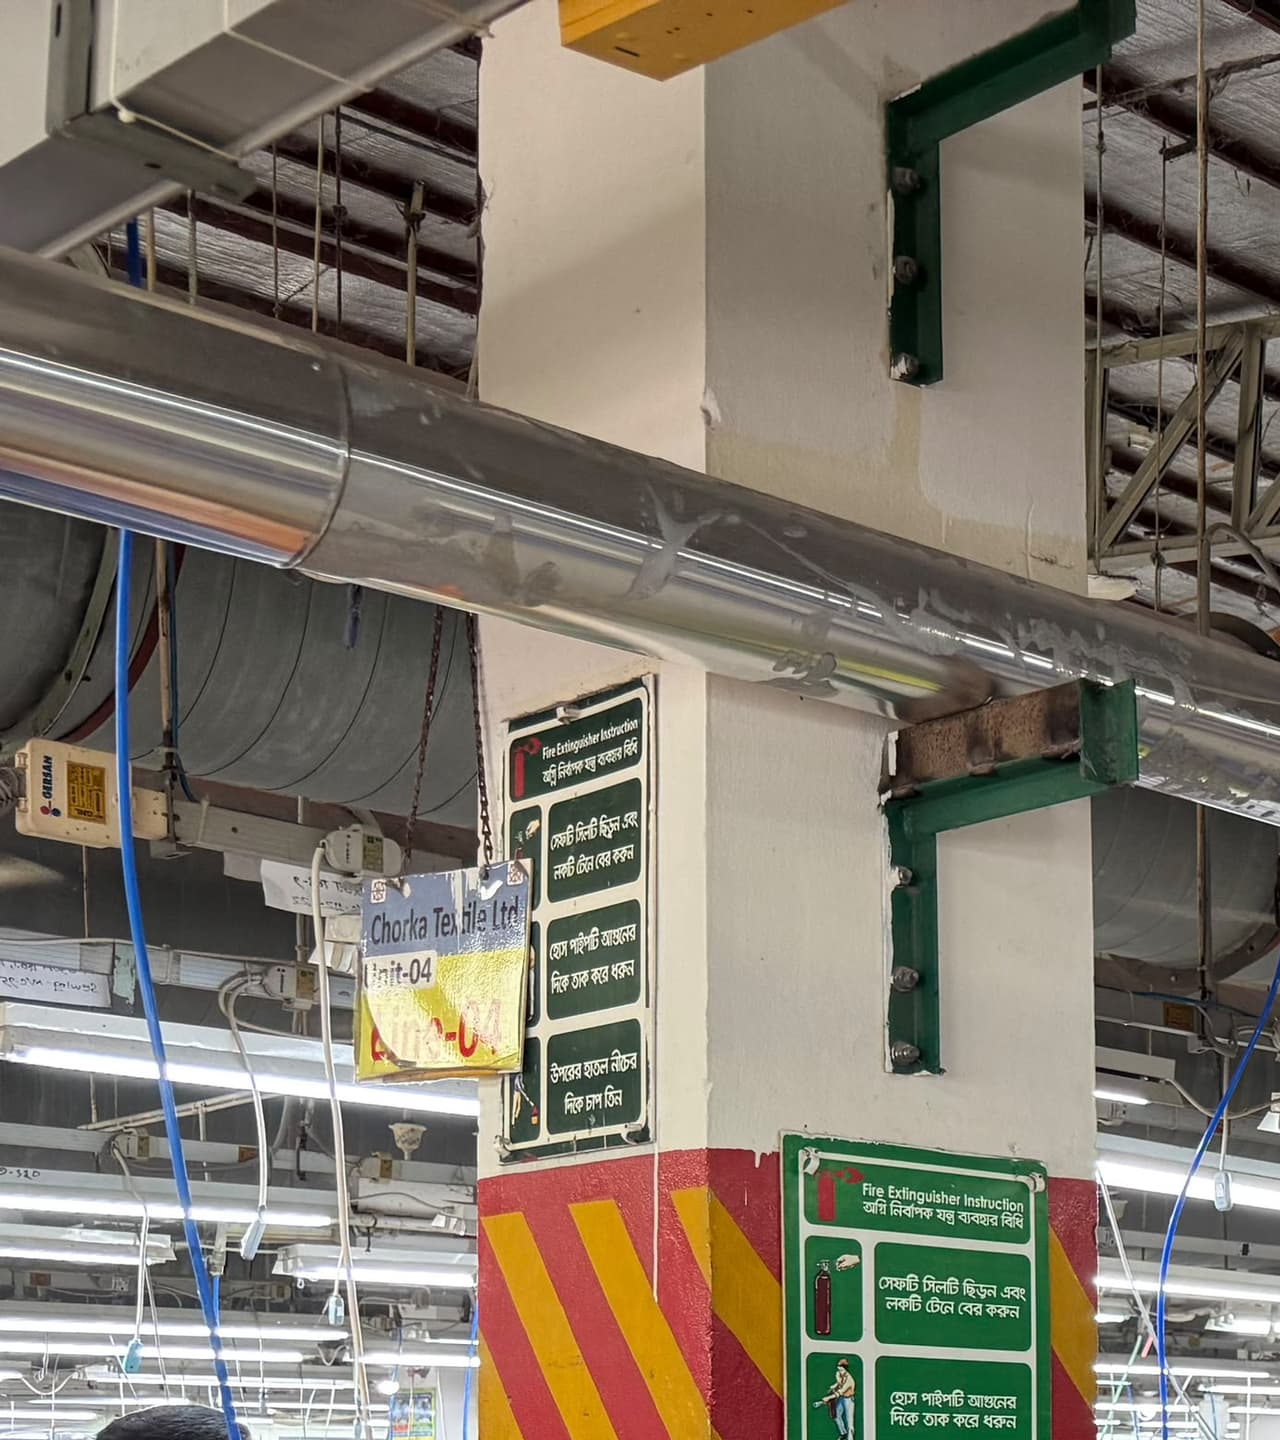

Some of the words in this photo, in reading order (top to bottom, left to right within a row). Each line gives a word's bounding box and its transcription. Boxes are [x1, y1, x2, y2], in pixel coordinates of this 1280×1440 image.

[542, 744, 556, 760] Fire
[556, 732, 600, 757] Extinguisher
[600, 718, 639, 744] Instruction
[622, 809, 639, 829] এবং
[370, 908, 428, 945] Chorka
[492, 895, 519, 931] Ltd
[570, 970, 590, 991] তাক
[590, 967, 609, 985] করে
[550, 1062, 582, 1084] উপরের
[583, 1060, 609, 1079] হাতল
[585, 1094, 603, 1110] চাপ
[862, 1183, 884, 1198] Fire
[888, 1185, 961, 1207] Extinguisher
[964, 1193, 1024, 1213] Instruction
[890, 1199, 933, 1219] নির্বাপক
[958, 1211, 998, 1227] ব্যবহার
[1001, 1211, 1024, 1230] বিধি
[879, 1273, 920, 1292] সেফটি
[922, 1275, 960, 1296] সিলটি
[1000, 1285, 1026, 1303] এবং
[885, 1295, 922, 1312] লকটি
[925, 1296, 954, 1315] টেনে
[958, 1302, 983, 1317] বের
[985, 1304, 1020, 1319] করুন
[921, 1389, 965, 1408] পাইপটি
[968, 1394, 1017, 1409] আগুনের
[889, 1408, 920, 1428] দিকে
[922, 1412, 950, 1428] তাক
[952, 1413, 980, 1429] করে
[983, 1413, 1017, 1430] ধরুন
